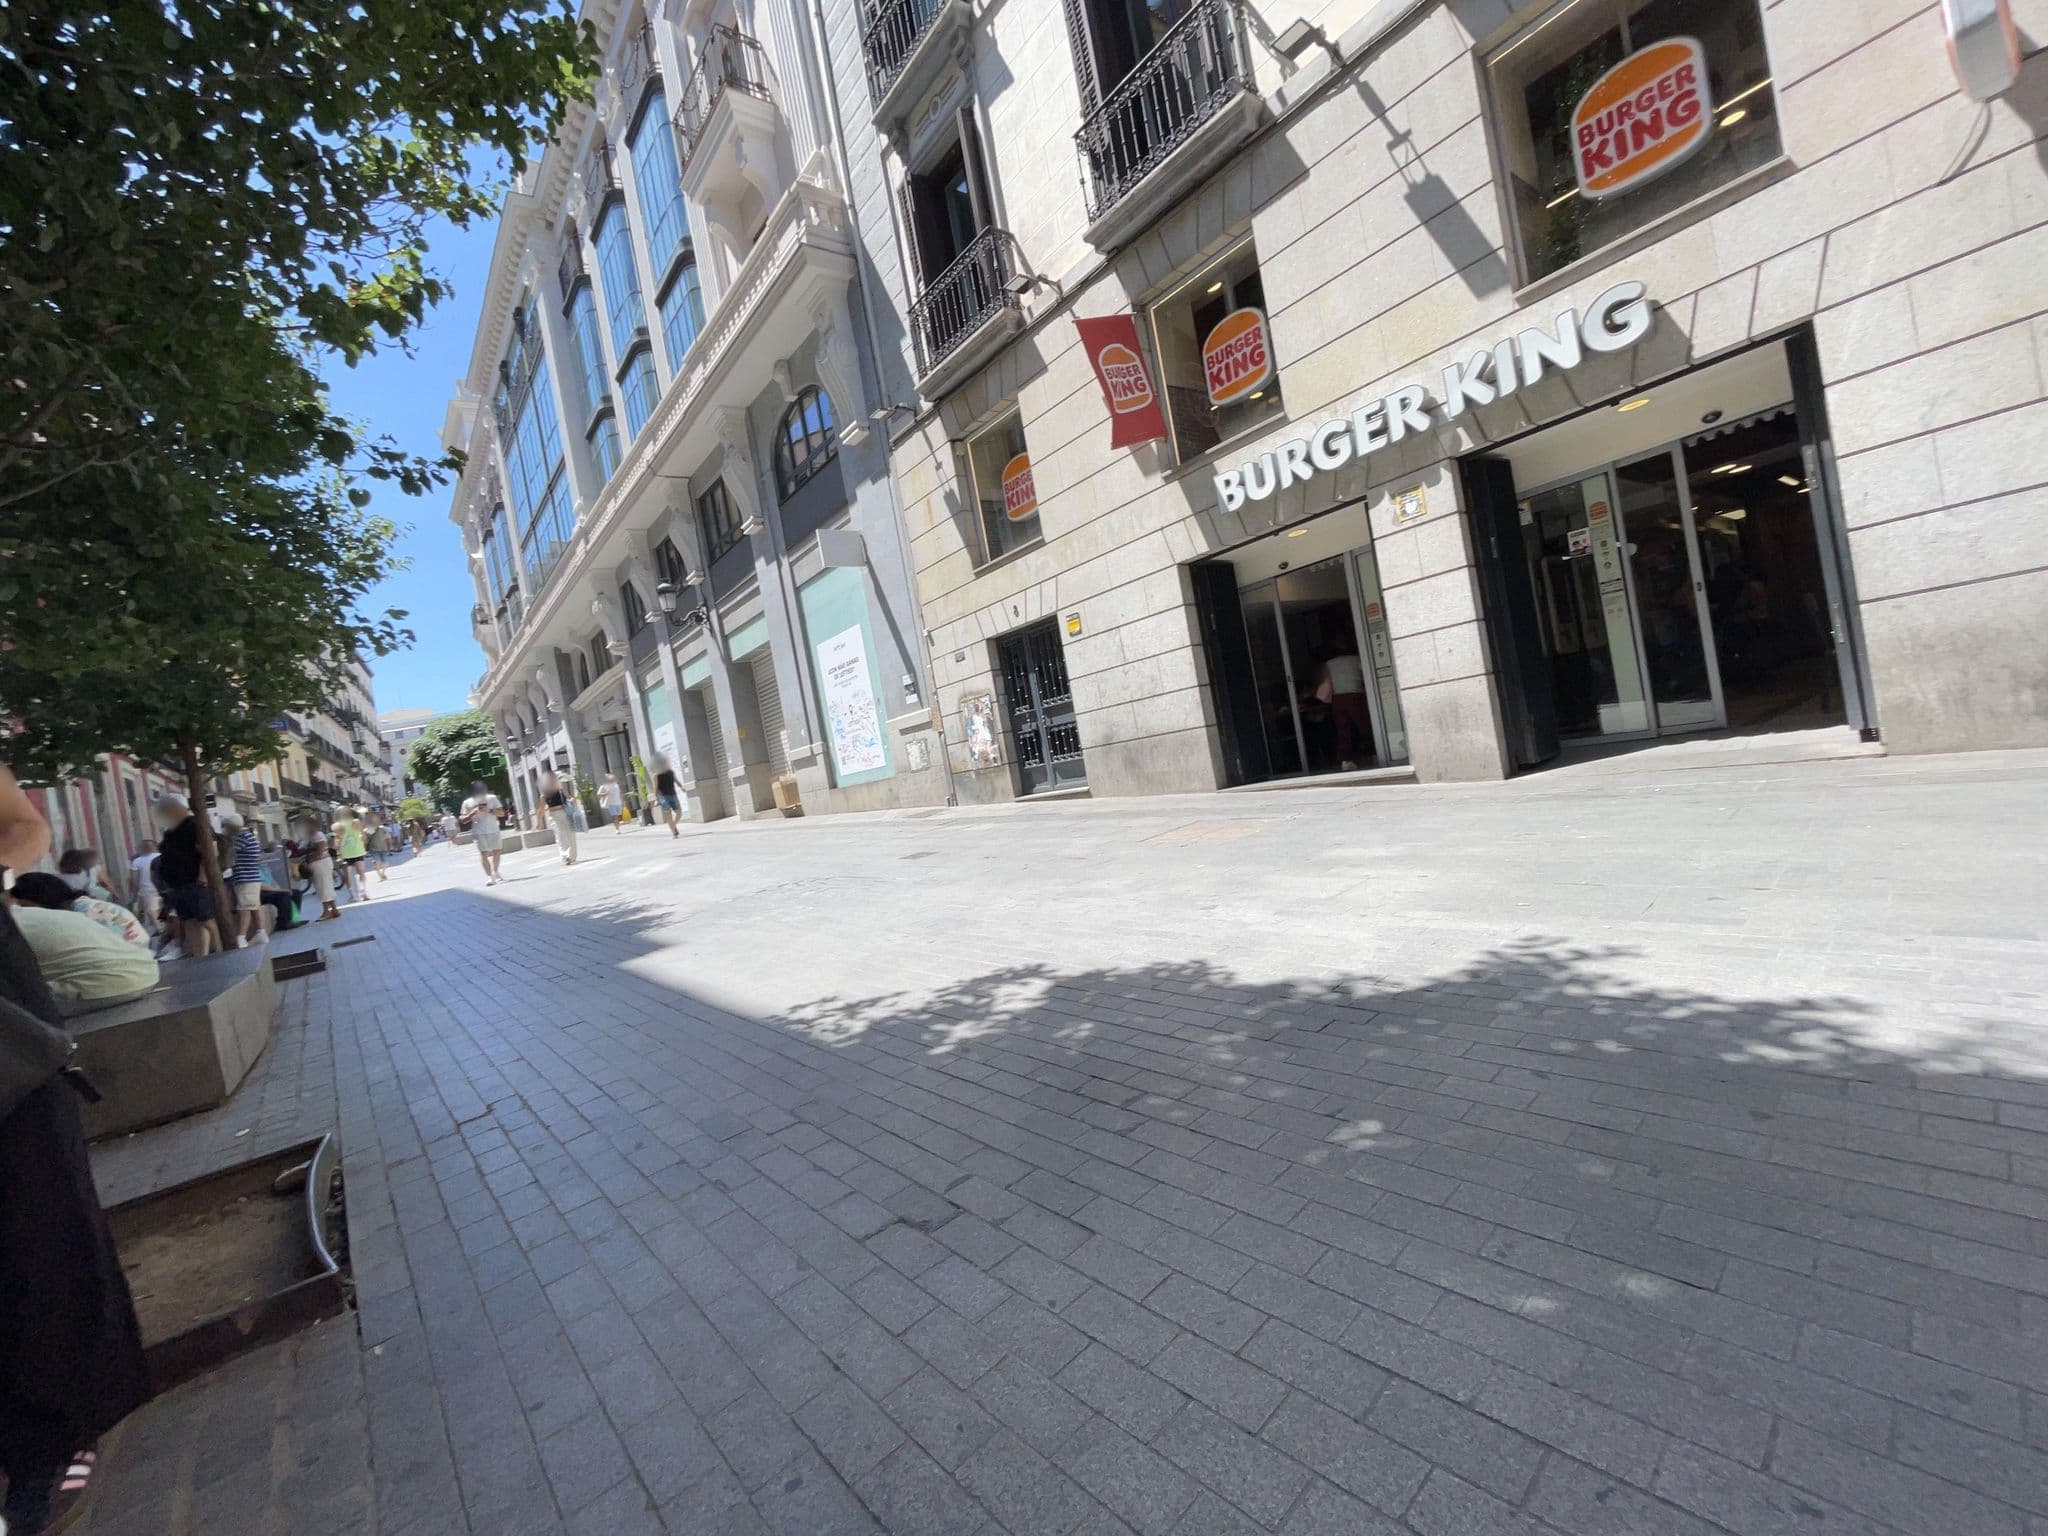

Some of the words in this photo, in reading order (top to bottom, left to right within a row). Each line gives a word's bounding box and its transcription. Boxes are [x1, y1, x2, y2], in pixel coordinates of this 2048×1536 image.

[1577, 64, 1697, 148] BURGER
[1581, 88, 1701, 179] KING
[1206, 326, 1263, 371] BURGER
[1208, 343, 1266, 392] KING
[1214, 383, 1432, 514] BURGER
[1442, 279, 1653, 419] KING
[1004, 468, 1033, 495] BURGE
